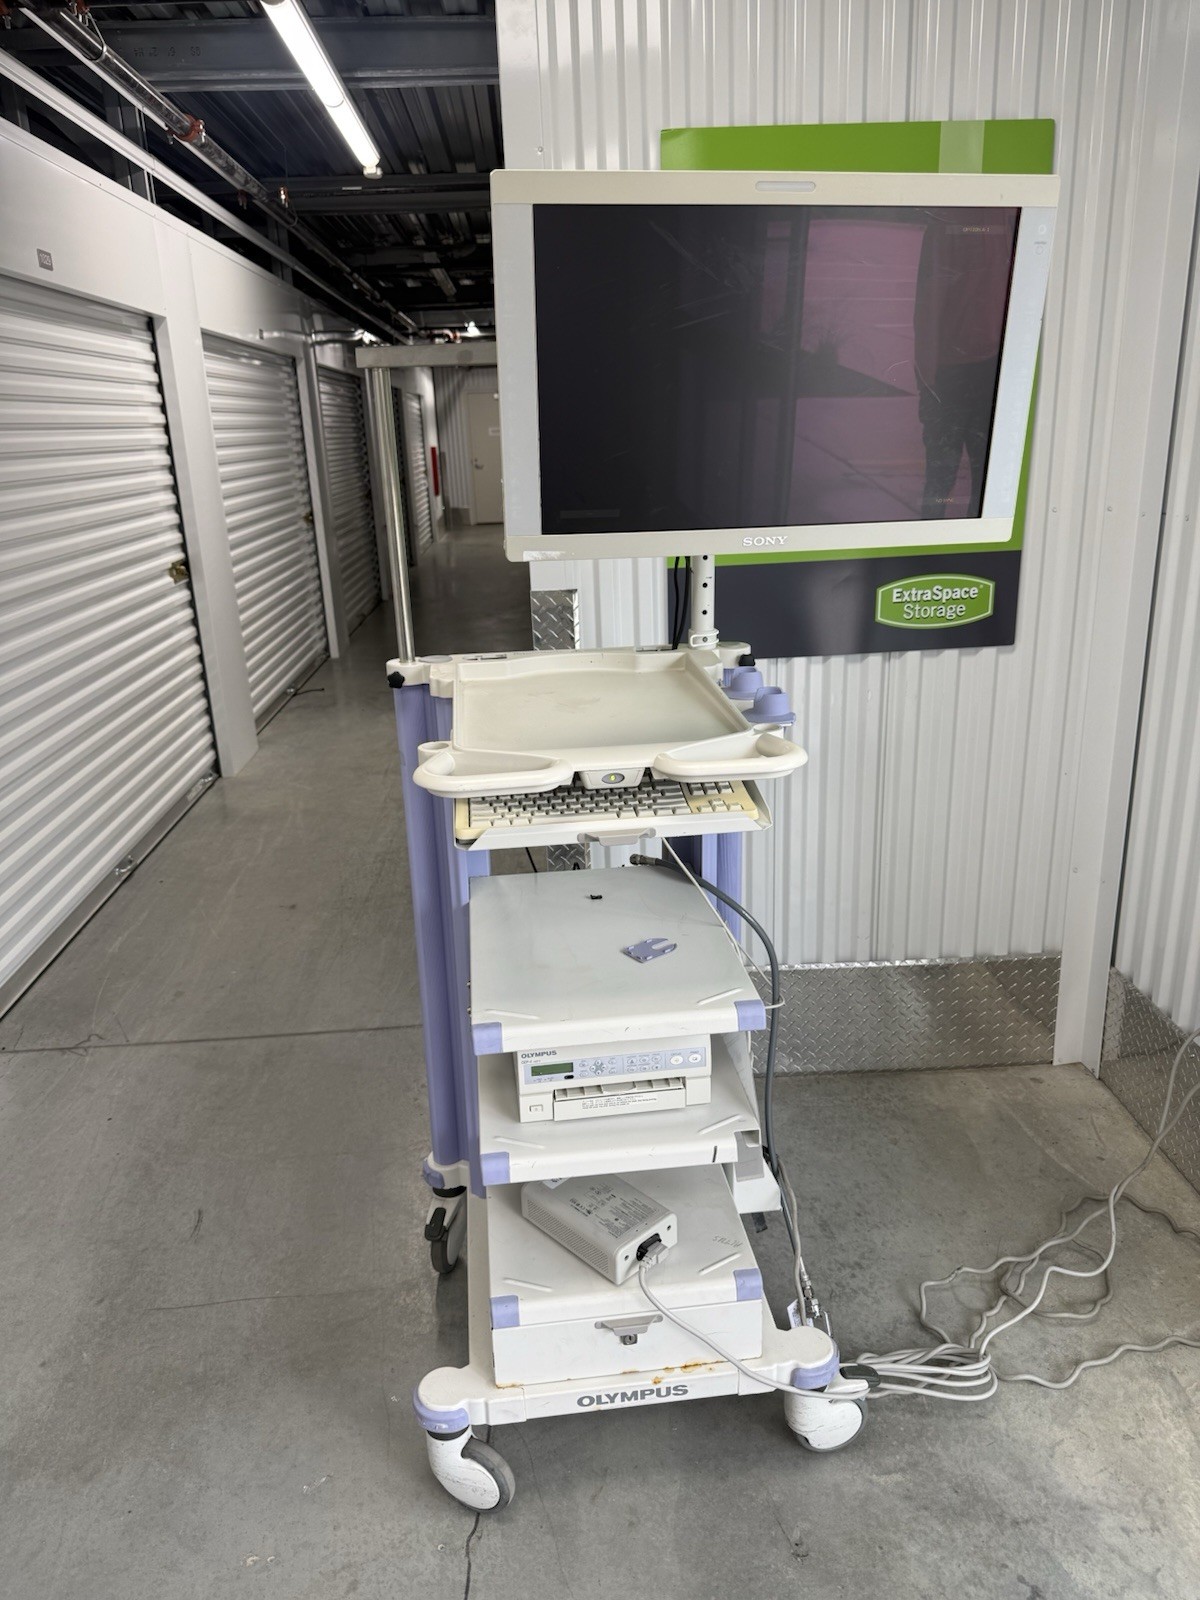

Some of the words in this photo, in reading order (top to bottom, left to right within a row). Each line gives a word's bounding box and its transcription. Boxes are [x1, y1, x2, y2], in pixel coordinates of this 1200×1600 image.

[743, 536, 788, 547] SONY
[892, 585, 978, 603] ExtraSpace
[903, 603, 966, 620] Storage
[521, 1050, 557, 1059] OLYMPUS
[576, 1384, 689, 1408] OLYMPUS
